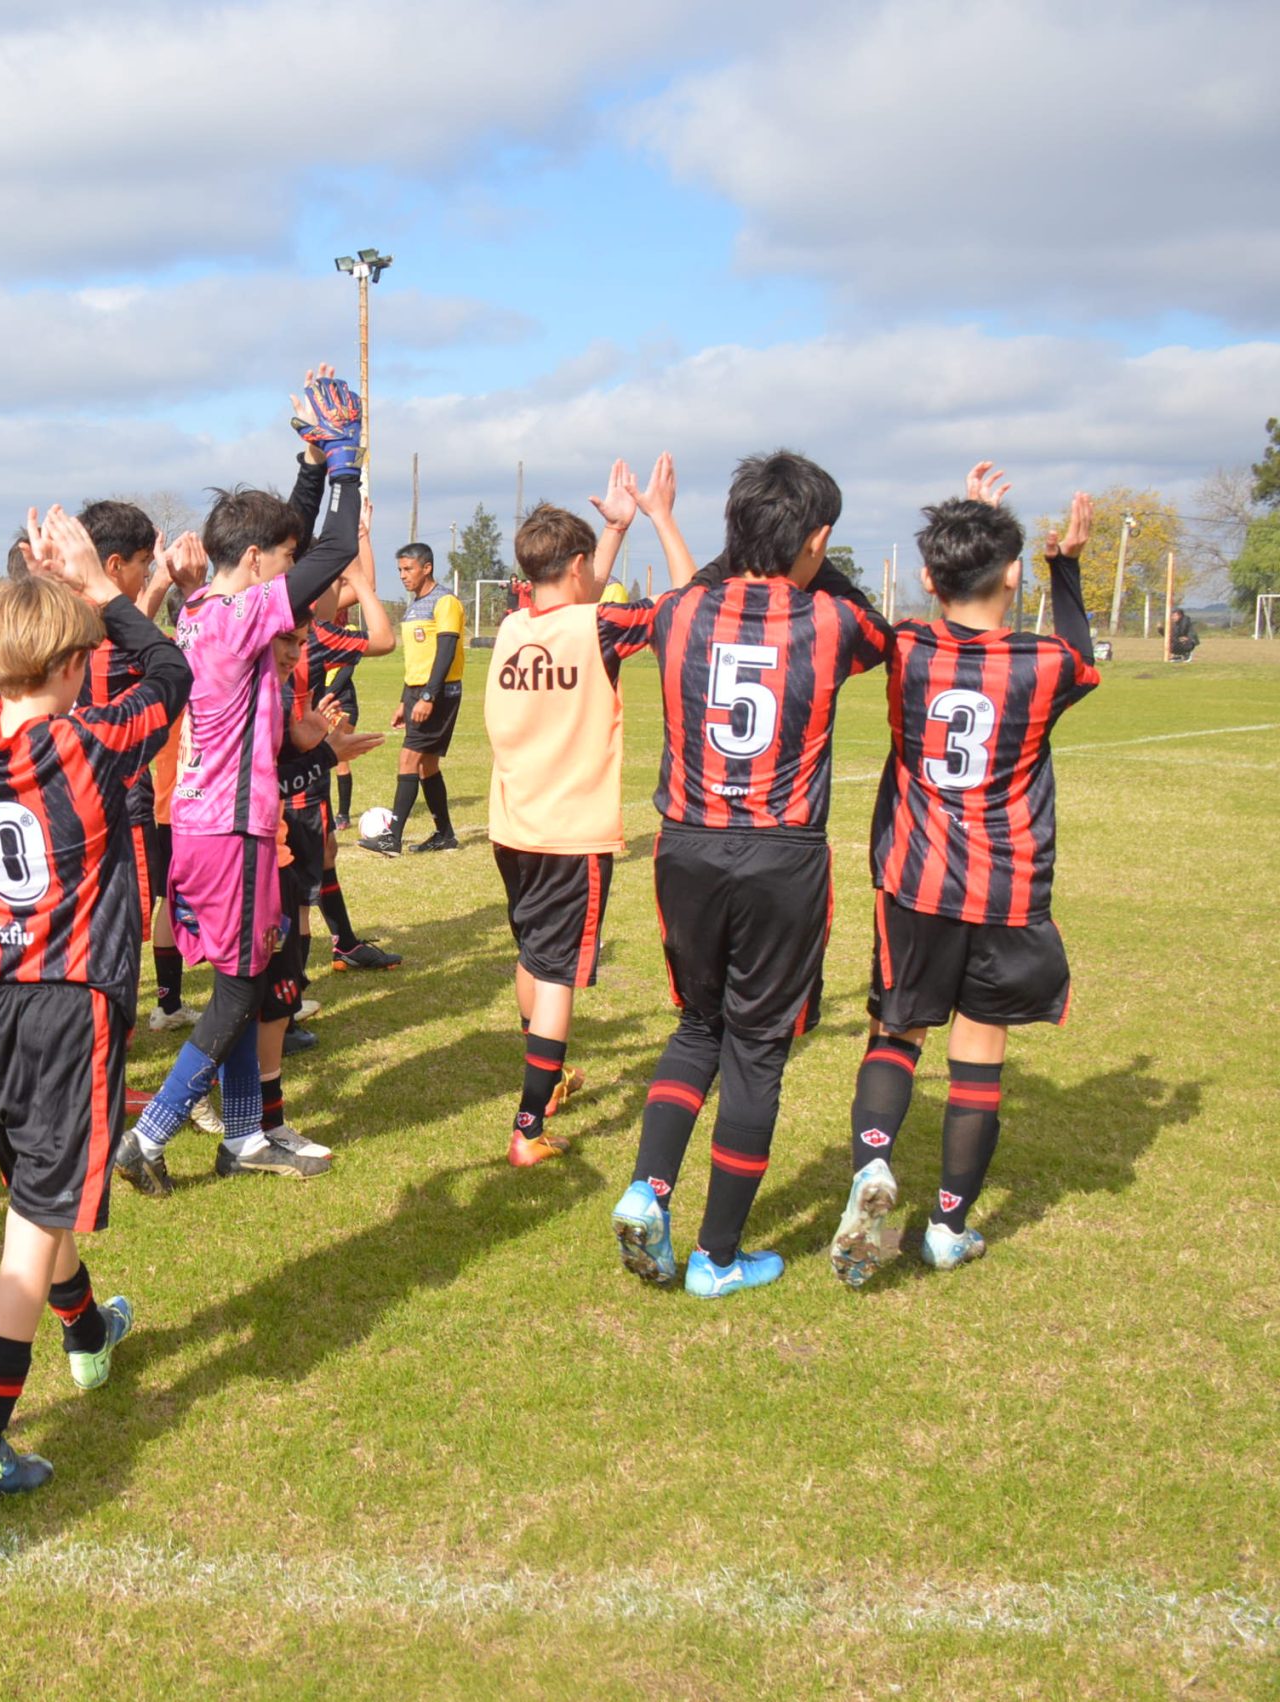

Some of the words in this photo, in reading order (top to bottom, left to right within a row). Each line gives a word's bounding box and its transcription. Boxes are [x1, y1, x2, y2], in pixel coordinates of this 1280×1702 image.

[499, 643, 578, 690] axfiu
[706, 642, 779, 760] 5
[923, 689, 996, 791] 3
